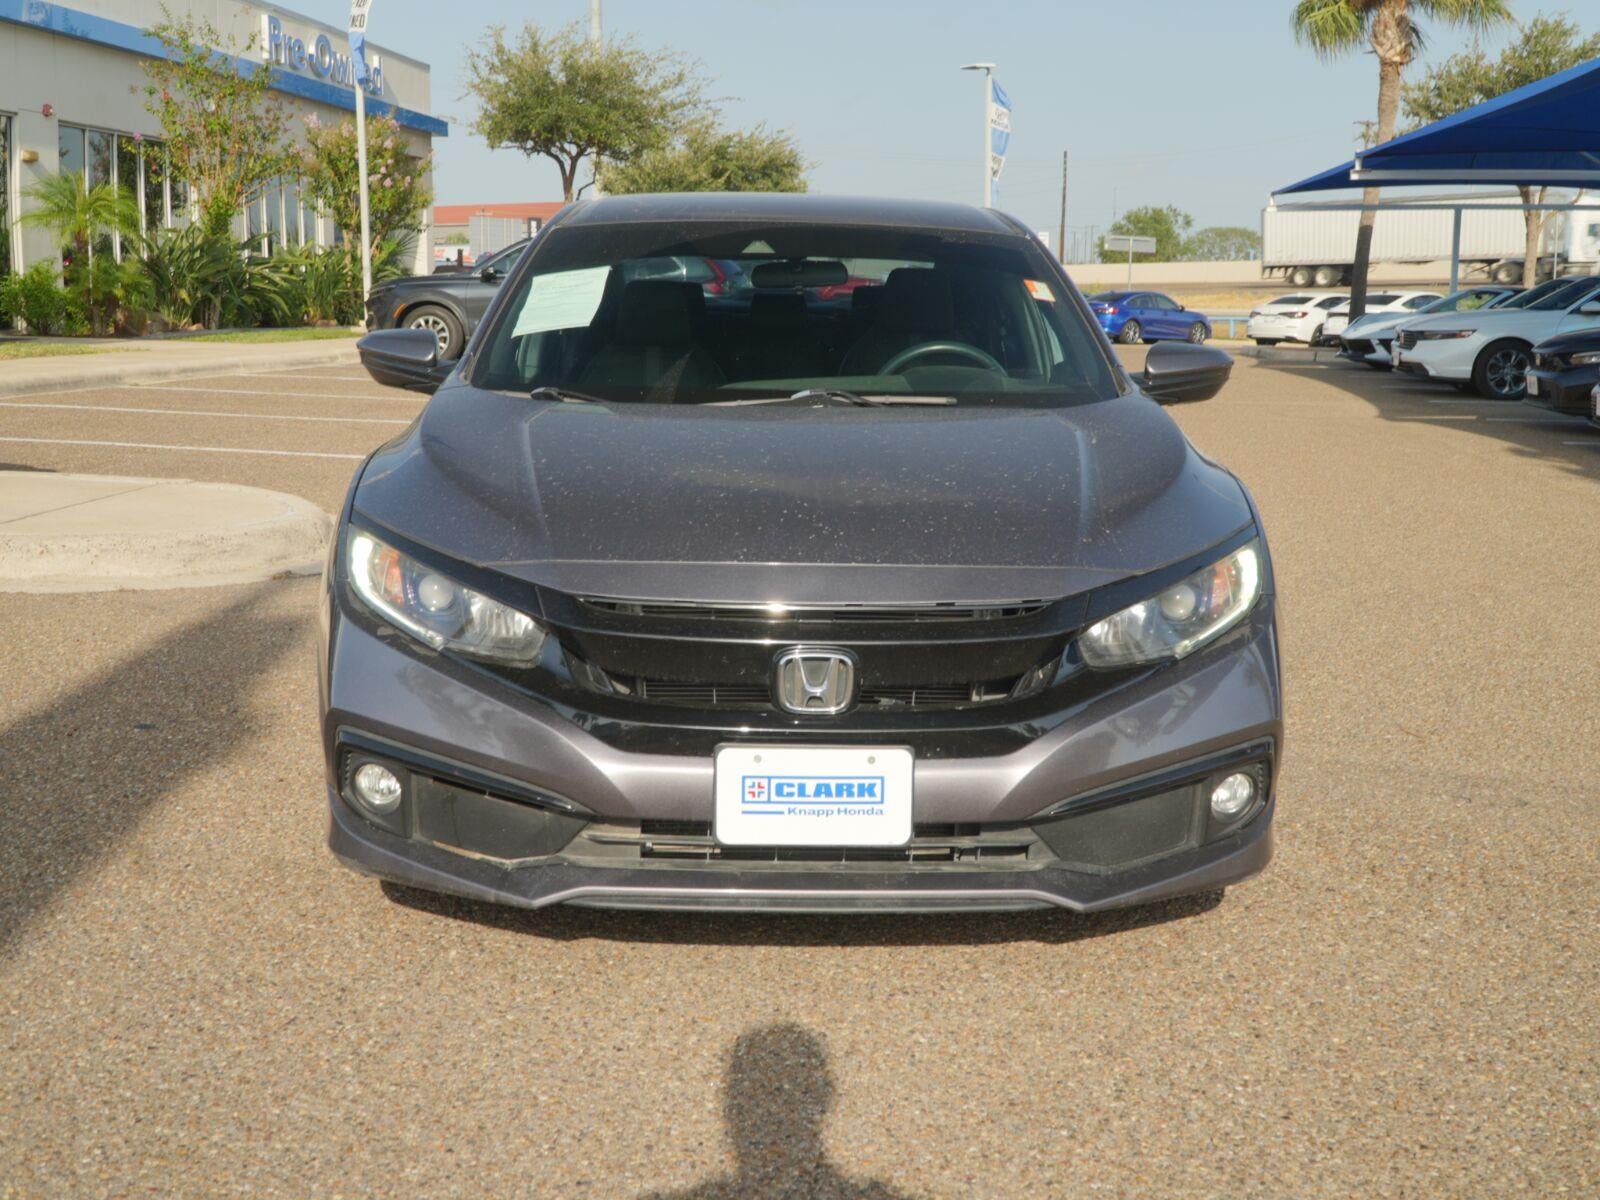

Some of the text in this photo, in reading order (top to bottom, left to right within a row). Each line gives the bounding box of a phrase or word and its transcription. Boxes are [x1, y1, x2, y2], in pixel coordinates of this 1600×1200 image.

[775, 782, 877, 798] CLARK
[787, 806, 884, 818] Knapp Honda
